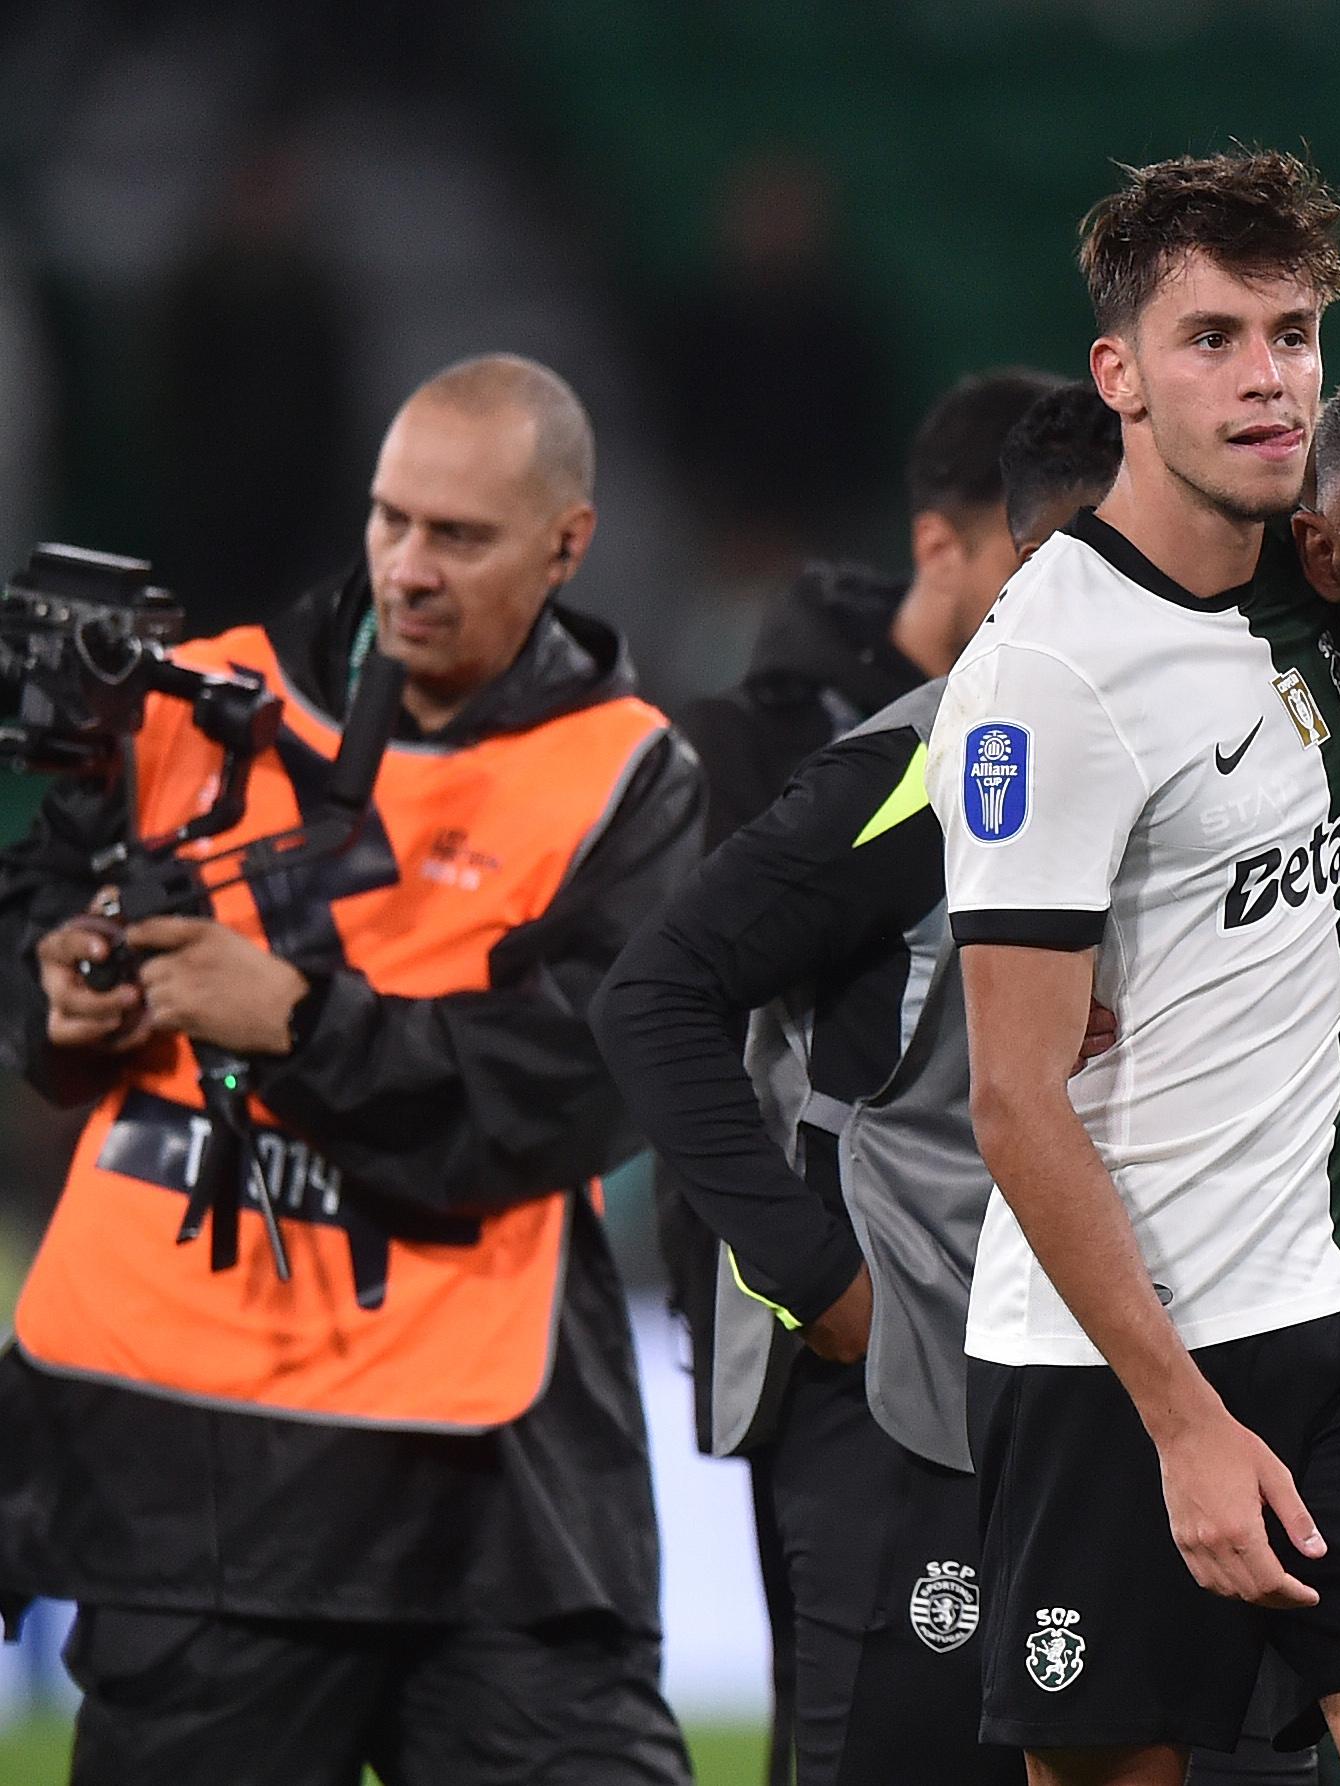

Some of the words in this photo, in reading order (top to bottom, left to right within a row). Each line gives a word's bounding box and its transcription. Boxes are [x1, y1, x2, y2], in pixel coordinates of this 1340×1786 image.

[971, 763, 1018, 777] Allianz
[983, 777, 1003, 787] CUP
[926, 1561, 976, 1579] SCP
